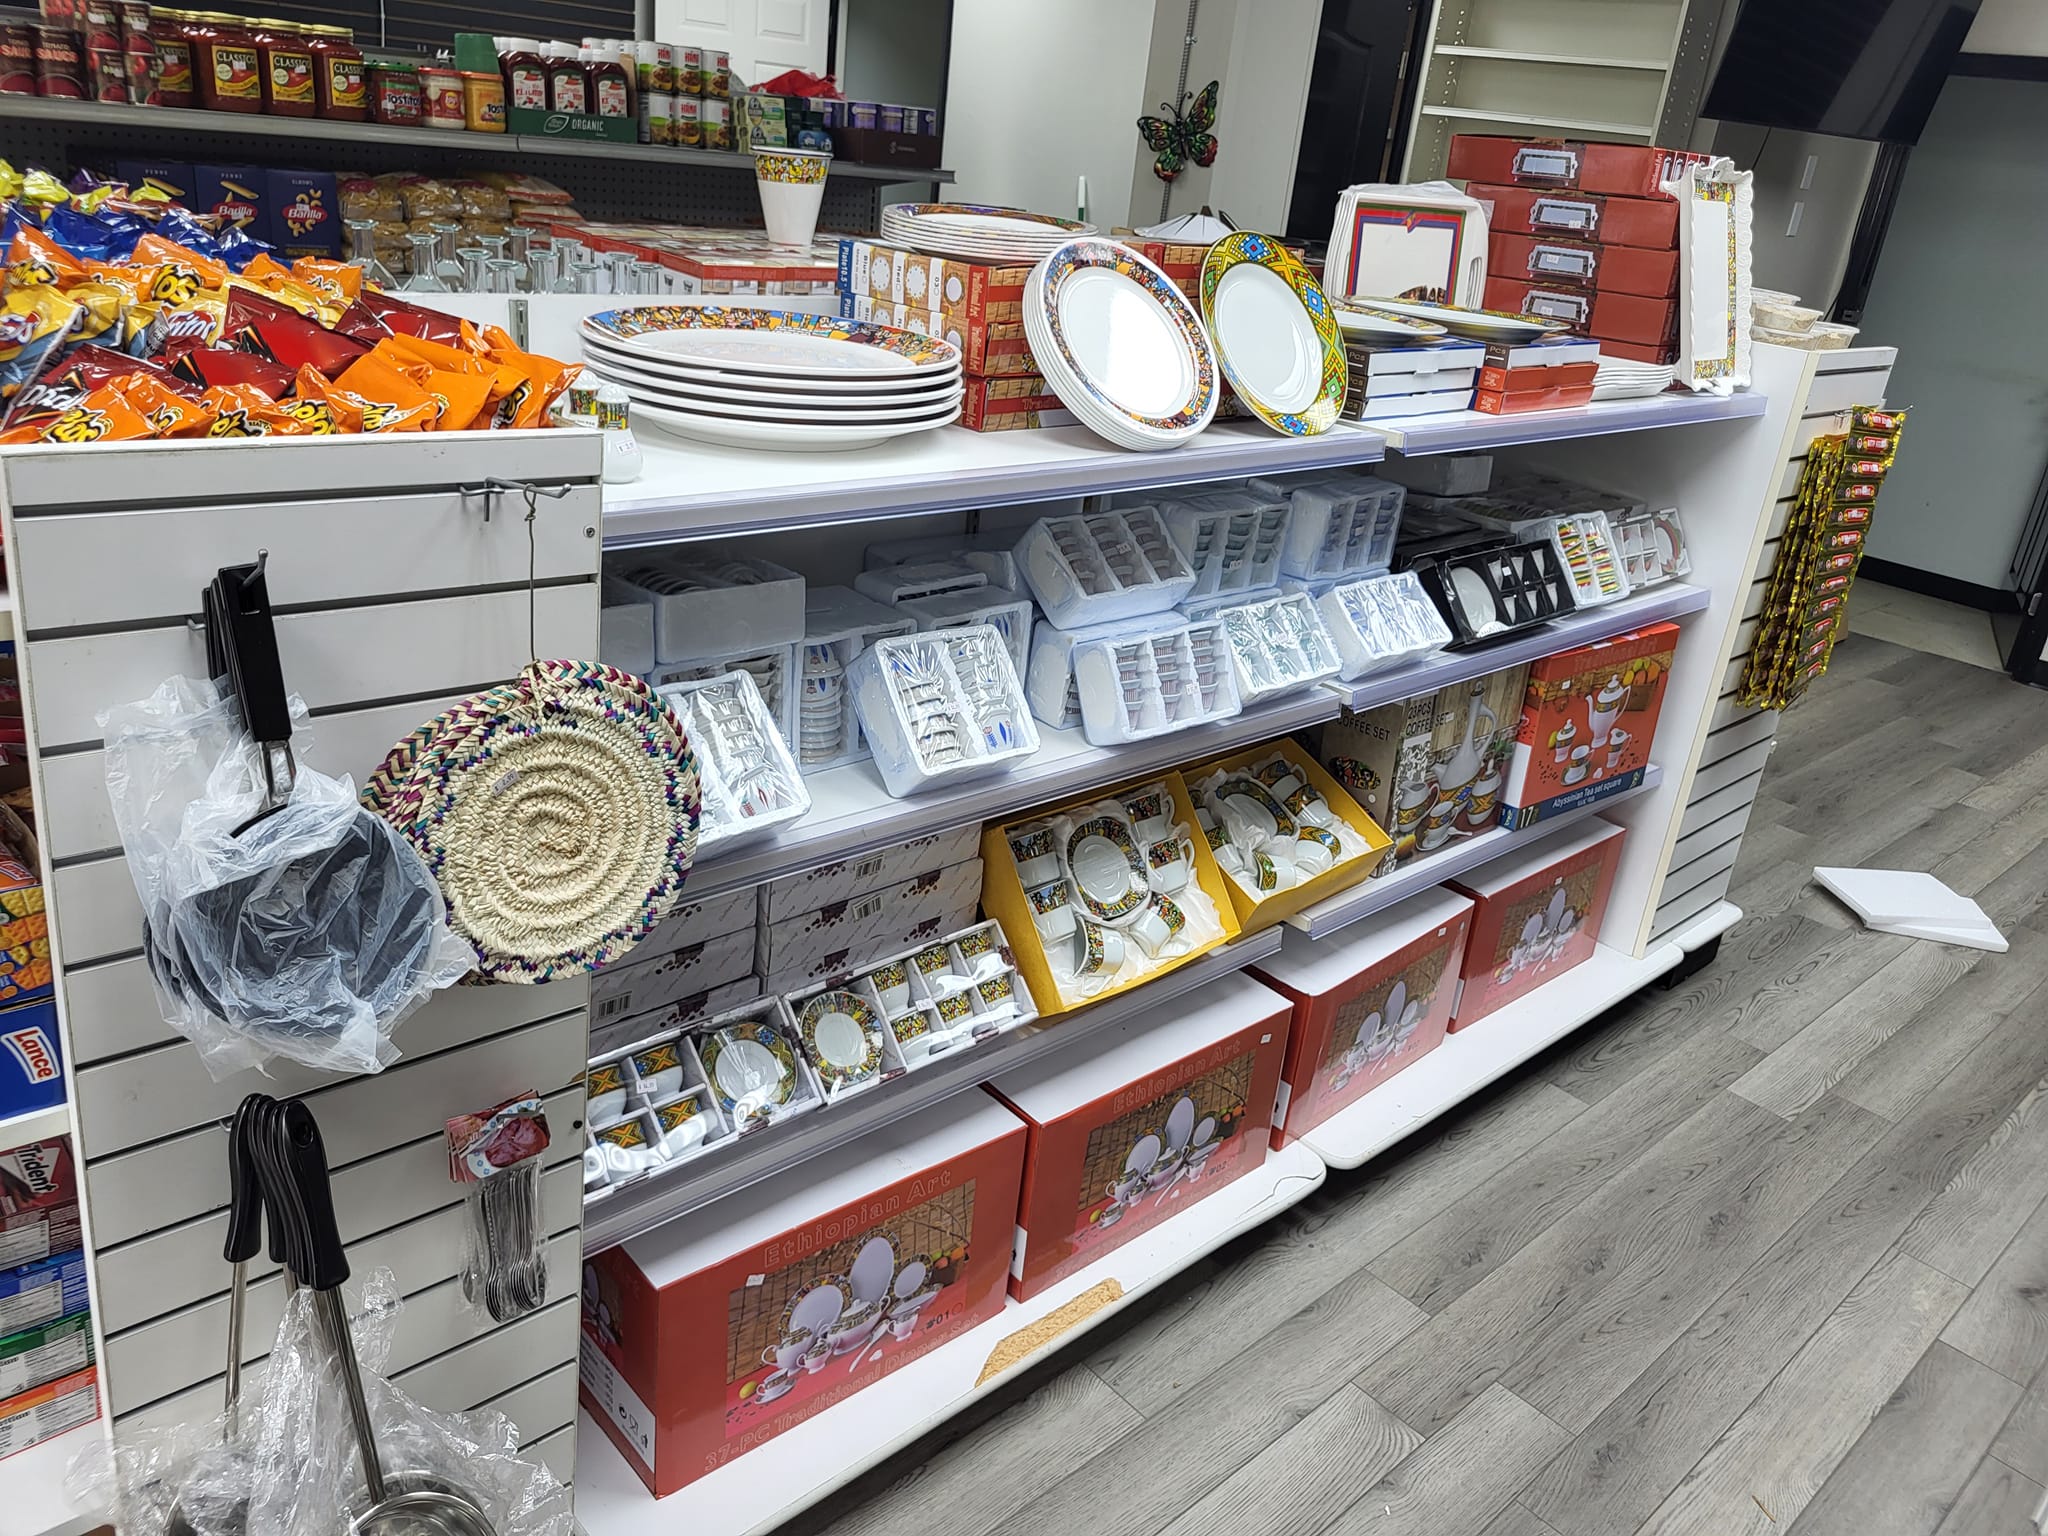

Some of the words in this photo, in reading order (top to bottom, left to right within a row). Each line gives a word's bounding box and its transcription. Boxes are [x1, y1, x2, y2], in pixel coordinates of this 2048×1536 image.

[571, 119, 604, 131] ORGANIC
[218, 205, 254, 218] Barilla
[287, 207, 322, 220] Barilla
[1408, 701, 1432, 719] 23PCS
[1373, 725, 1391, 741] SET
[1405, 717, 1433, 736] COFFEE
[1584, 787, 1594, 797] Tea
[1603, 778, 1622, 791] square
[14, 1029, 53, 1079] Lance
[1113, 1057, 1206, 1114] Ethiopian
[1207, 1038, 1241, 1062] Art
[17, 1143, 58, 1193] Trident
[764, 1193, 900, 1268] Ethiopian
[907, 1170, 951, 1202] Art
[925, 1313, 951, 1331] #01
[704, 1423, 771, 1473] 37-PC
[773, 1362, 880, 1433] Traditional
[884, 1329, 948, 1374] Dinner
[949, 1312, 980, 1339] Set
